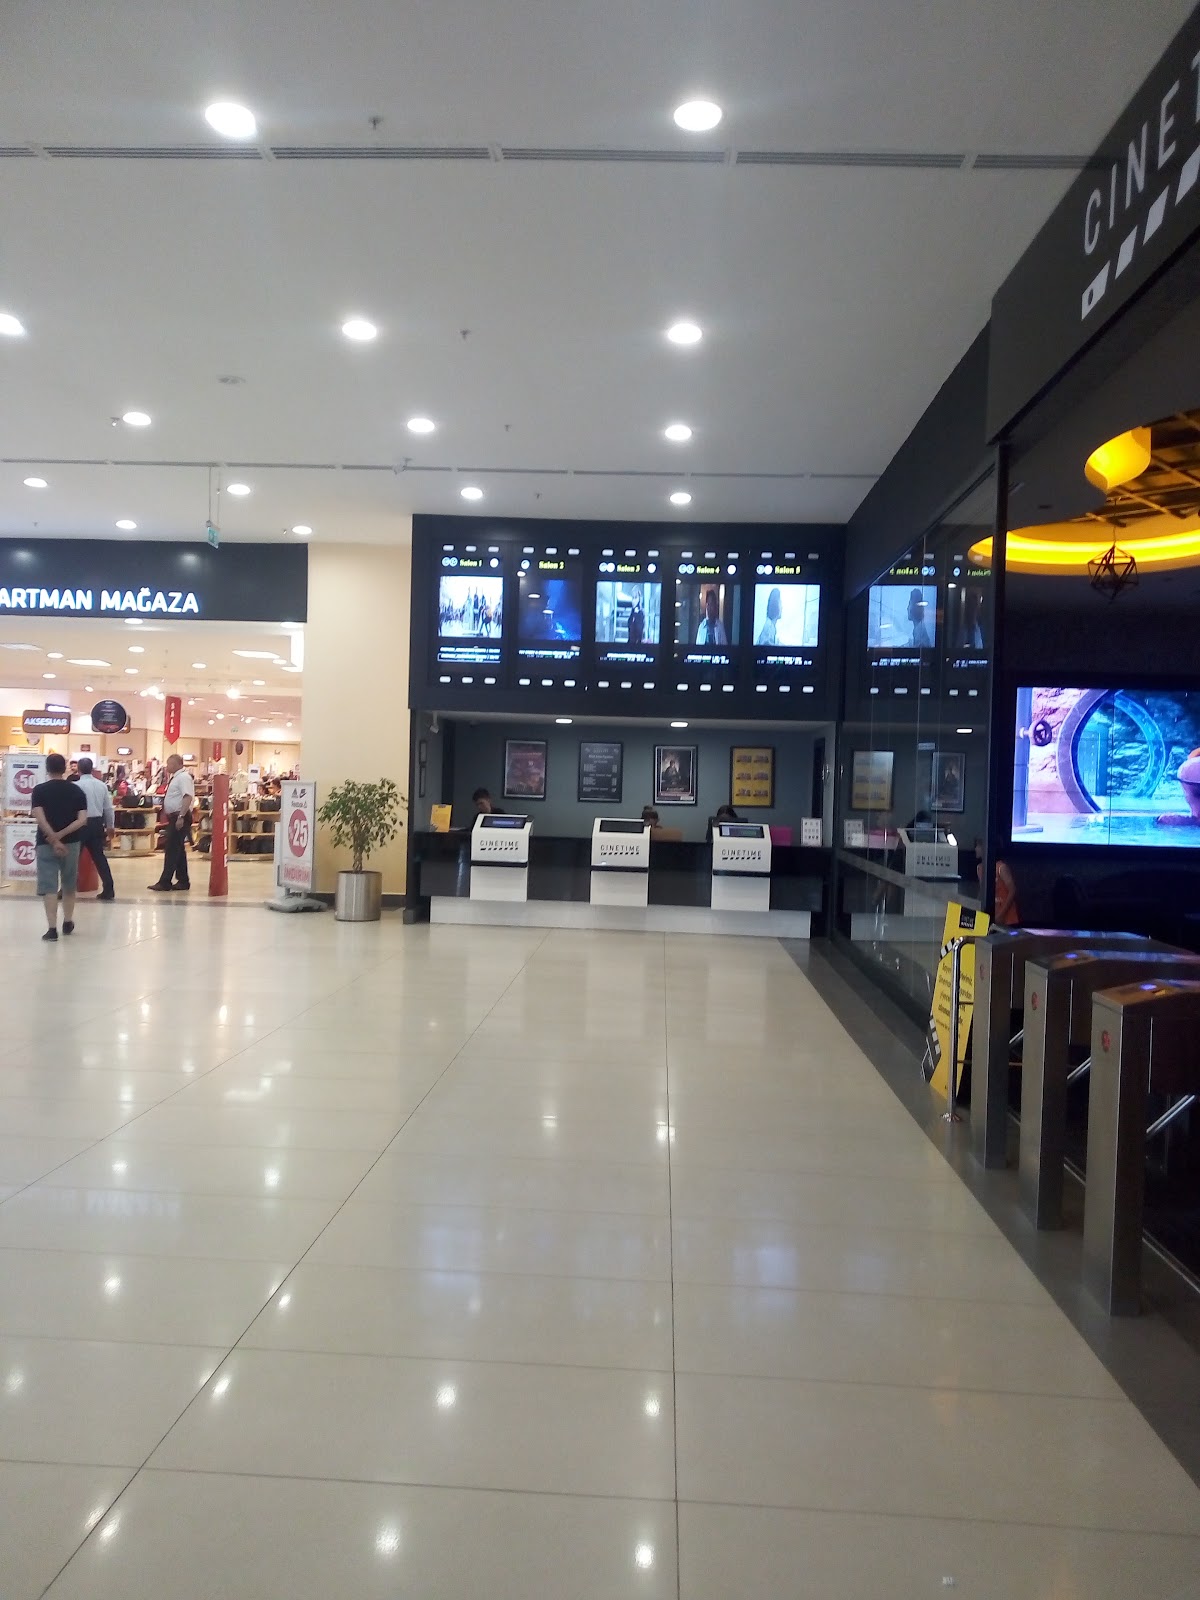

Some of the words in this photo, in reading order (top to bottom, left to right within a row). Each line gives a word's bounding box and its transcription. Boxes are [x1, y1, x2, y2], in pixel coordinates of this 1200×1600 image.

[459, 559, 477, 567] Salon
[478, 559, 483, 567] 1
[538, 560, 558, 569] Salon
[559, 561, 565, 569] 2
[617, 564, 634, 572] Salon
[635, 565, 640, 573] 3
[696, 565, 713, 574] Salon
[714, 566, 720, 574] 4
[774, 565, 794, 574] Salon
[101, 587, 199, 613] MAĞAZA
[480, 839, 519, 847] CINETIME
[600, 844, 640, 852] CINETIME
[721, 849, 762, 857] CINETIME
